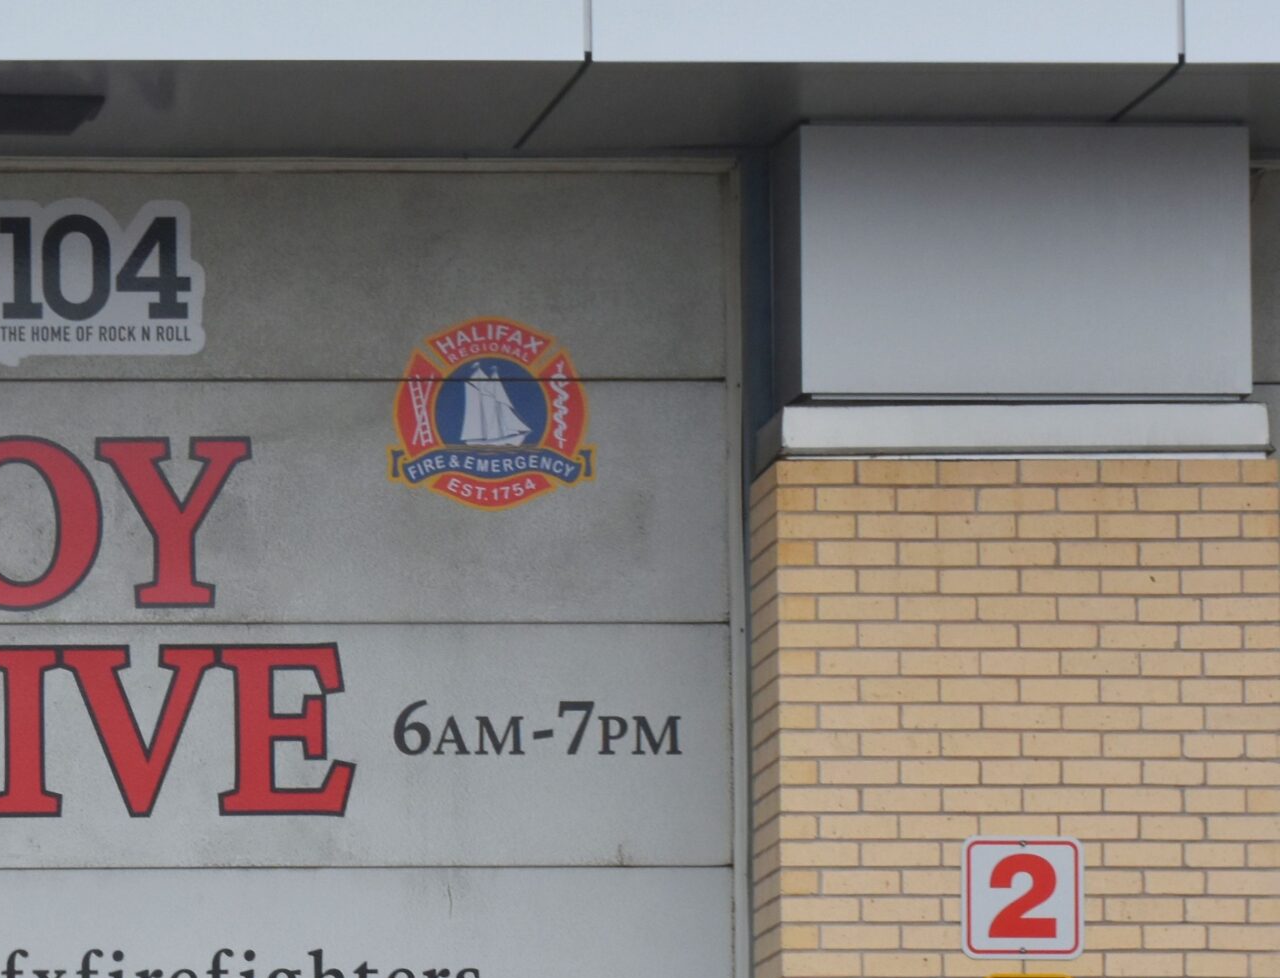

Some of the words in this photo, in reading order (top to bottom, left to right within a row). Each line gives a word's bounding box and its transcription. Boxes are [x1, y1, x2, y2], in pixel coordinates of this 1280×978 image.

[1, 325, 26, 342] THE
[31, 325, 71, 342] HOME
[76, 325, 94, 342] OF
[99, 325, 136, 342] ROCK
[141, 325, 151, 342] N
[156, 325, 191, 342] ROLL
[436, 324, 544, 354] HALIFAX
[448, 342, 529, 363] REGIONAL
[393, 699, 682, 756] 6AM-7PM
[988, 853, 1057, 938] 2
